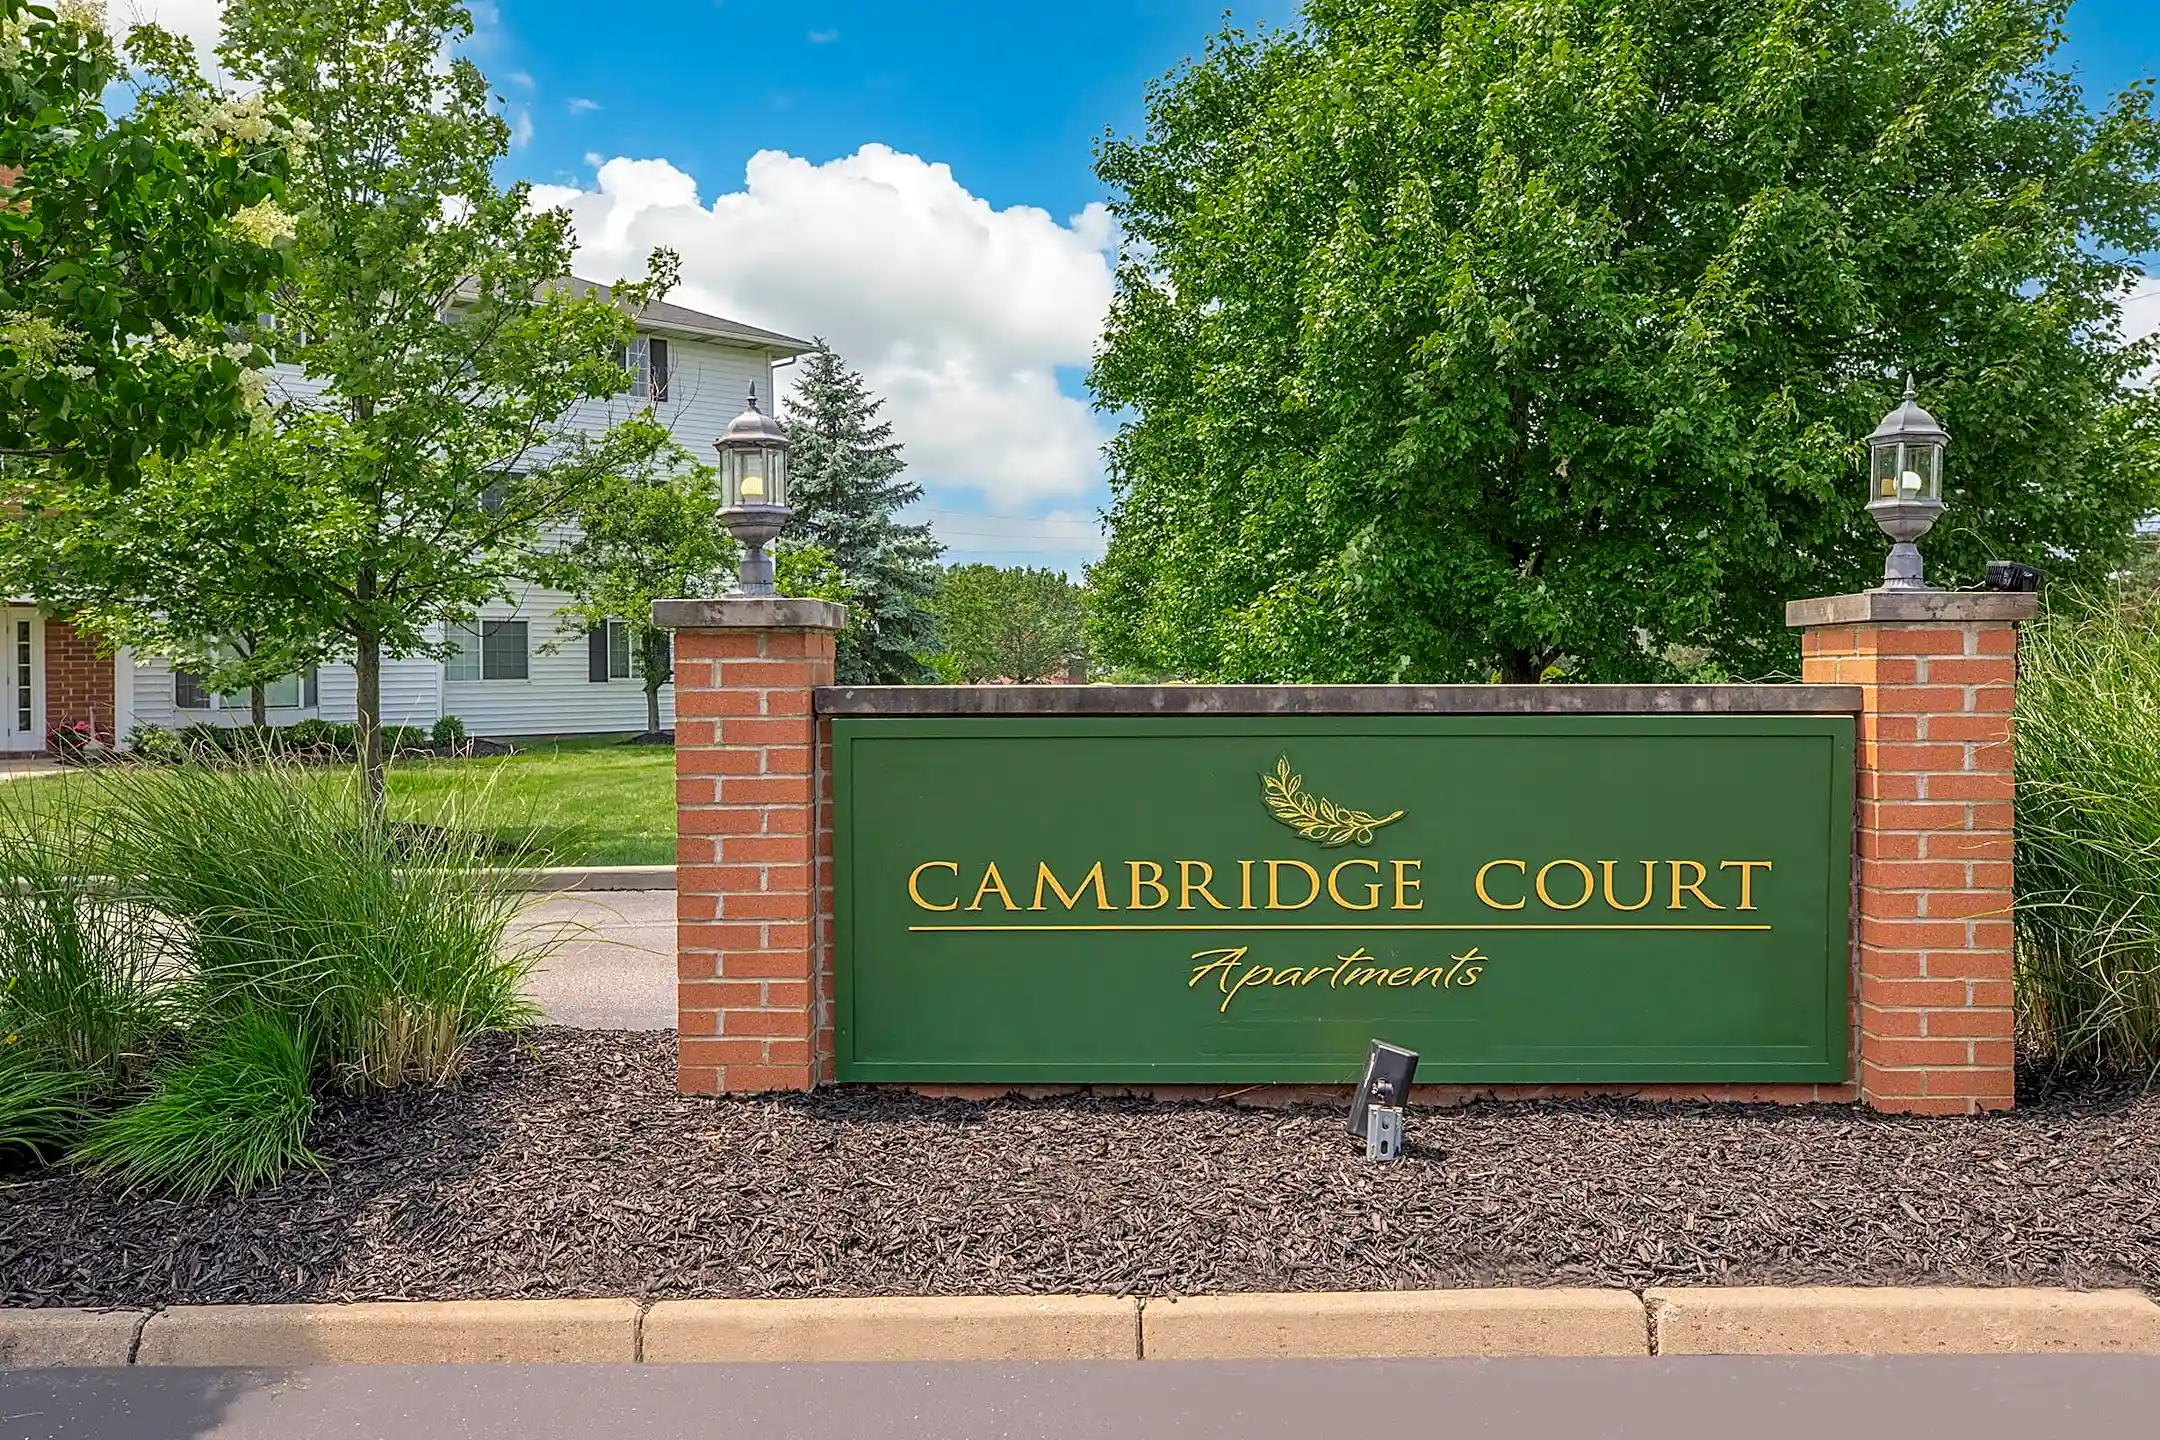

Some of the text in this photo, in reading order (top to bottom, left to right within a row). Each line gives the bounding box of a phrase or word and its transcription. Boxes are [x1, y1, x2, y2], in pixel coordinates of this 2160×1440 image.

[907, 858, 1773, 912] CAMBRIDGE COURT
[1188, 945, 1487, 1013] Apartments
